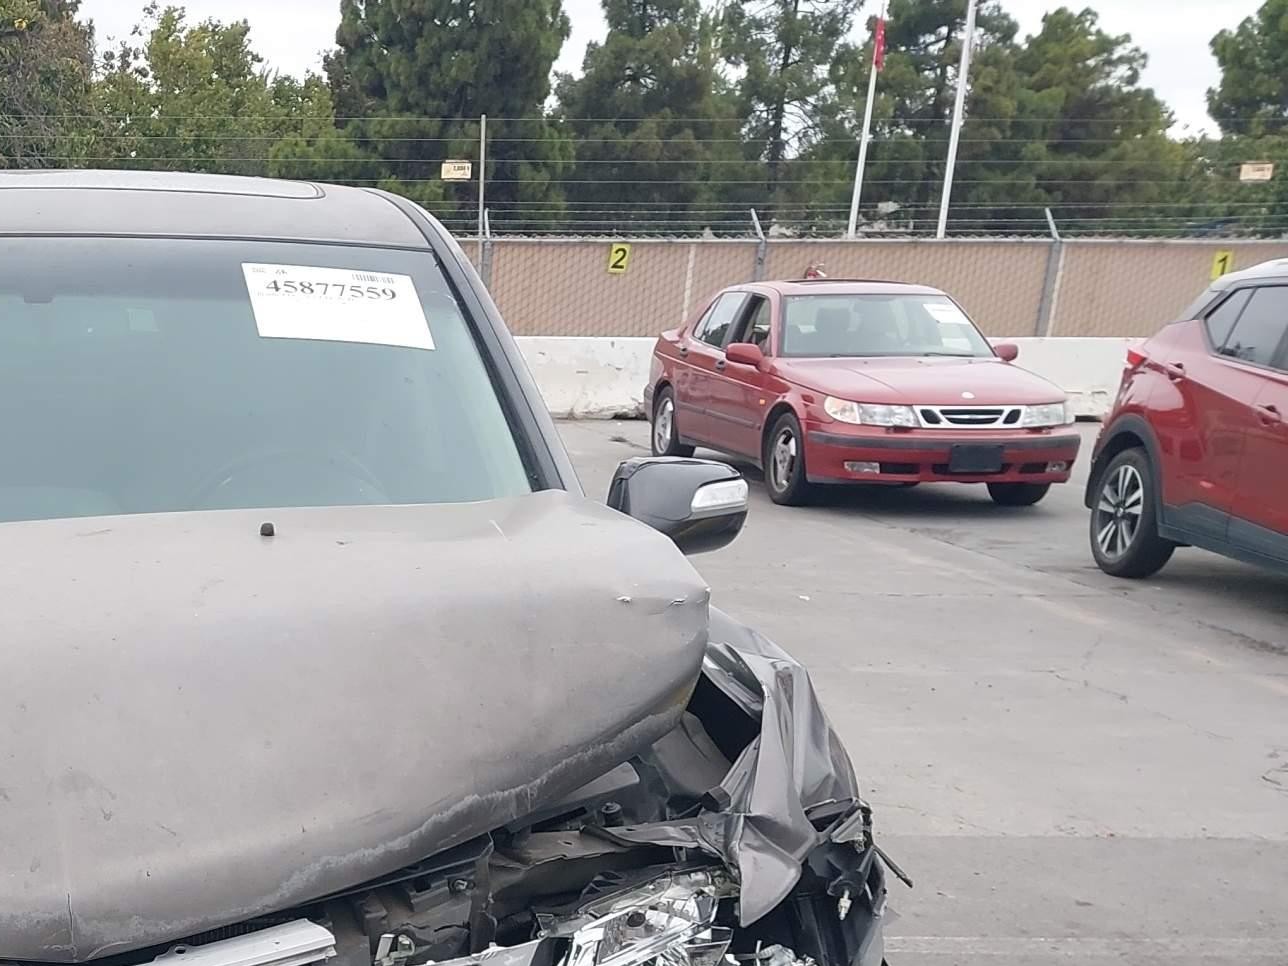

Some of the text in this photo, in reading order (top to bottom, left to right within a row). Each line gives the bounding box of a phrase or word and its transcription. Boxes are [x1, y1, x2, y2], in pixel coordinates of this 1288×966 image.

[610, 247, 627, 270] 2
[1217, 254, 1229, 277] 1
[265, 279, 397, 301] 45877559
